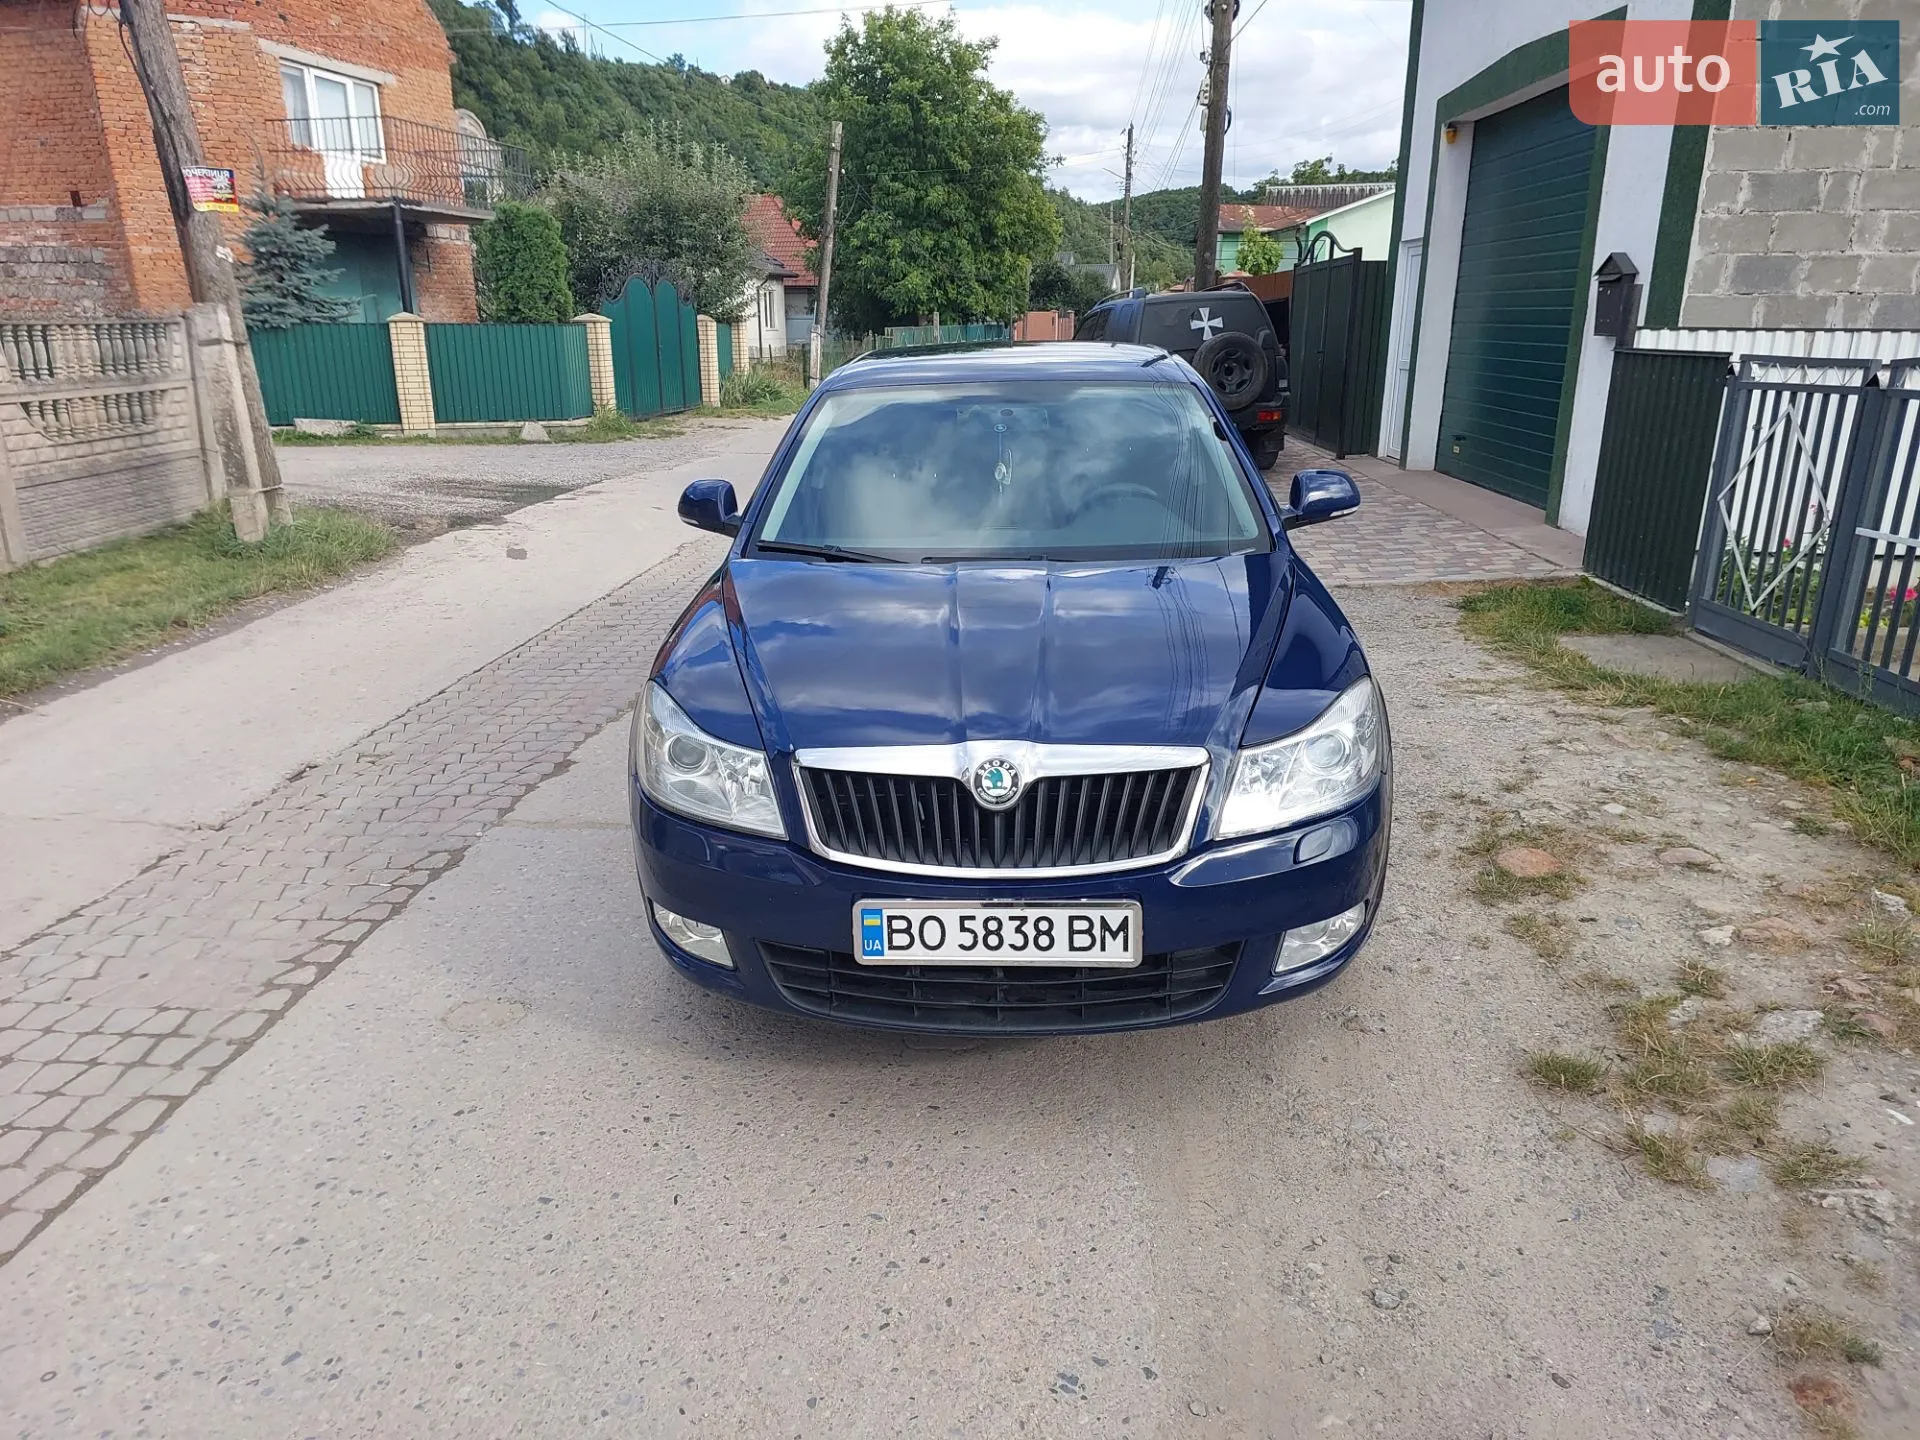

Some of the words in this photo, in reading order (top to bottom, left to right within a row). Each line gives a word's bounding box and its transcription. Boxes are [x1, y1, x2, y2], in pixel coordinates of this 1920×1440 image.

[864, 939, 882, 951] UA
[887, 915, 946, 951] BO
[958, 915, 1055, 951] 5838
[1068, 915, 1129, 952] BM
